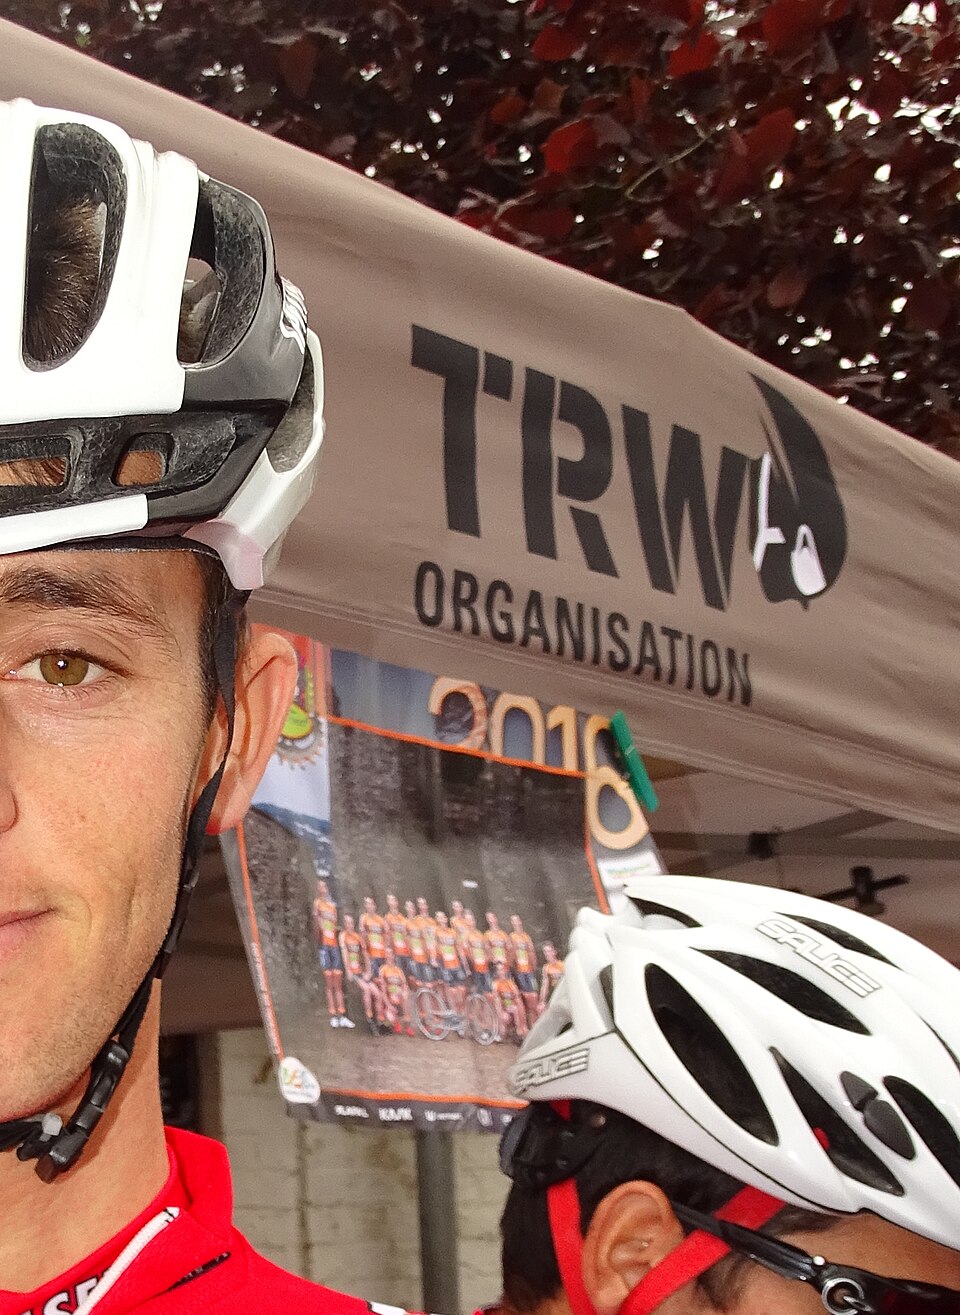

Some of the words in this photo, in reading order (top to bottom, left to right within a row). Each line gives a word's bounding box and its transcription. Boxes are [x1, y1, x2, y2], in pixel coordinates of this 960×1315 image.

[411, 324, 752, 612] TRW
[414, 560, 753, 706] ORGANISATION
[428, 675, 649, 850] 2016
